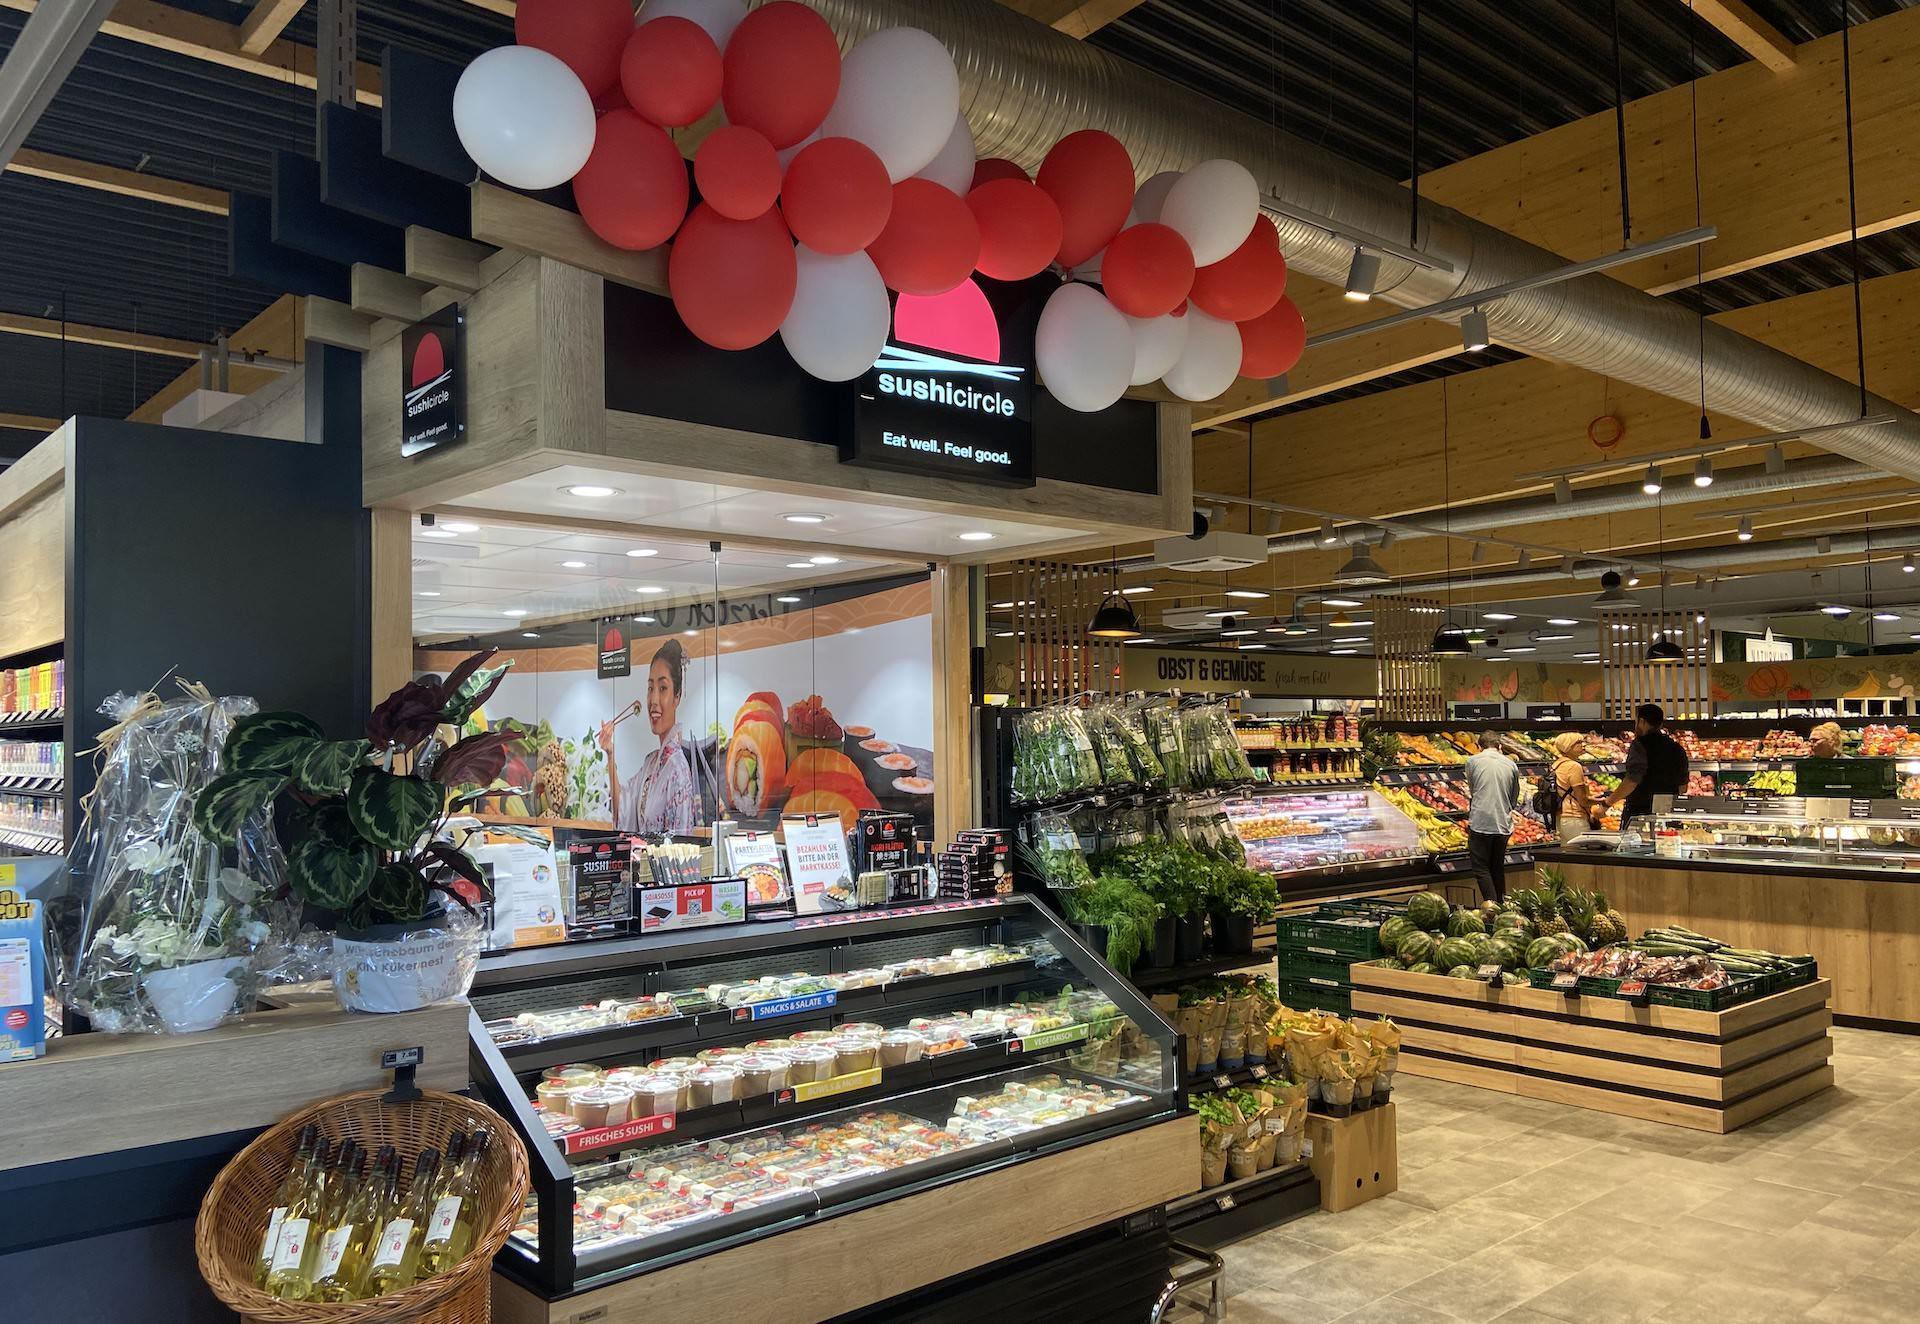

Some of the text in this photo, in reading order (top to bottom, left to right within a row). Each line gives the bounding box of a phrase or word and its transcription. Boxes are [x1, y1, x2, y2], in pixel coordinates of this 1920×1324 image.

[408, 390, 449, 417] sushicircle
[878, 373, 1015, 416] sushicircle
[883, 431, 1012, 464] Eat well. Feel good.
[1158, 656, 1266, 682] OBST & GEMÜSE
[796, 843, 838, 855] BEZAHLEN SIE
[798, 852, 840, 863] BITTE AN DER
[760, 997, 822, 1015] SNACKS & SALATE
[1034, 1032, 1073, 1046] VEGETARISCH
[579, 1122, 654, 1147] FRISCHES SUSHI
